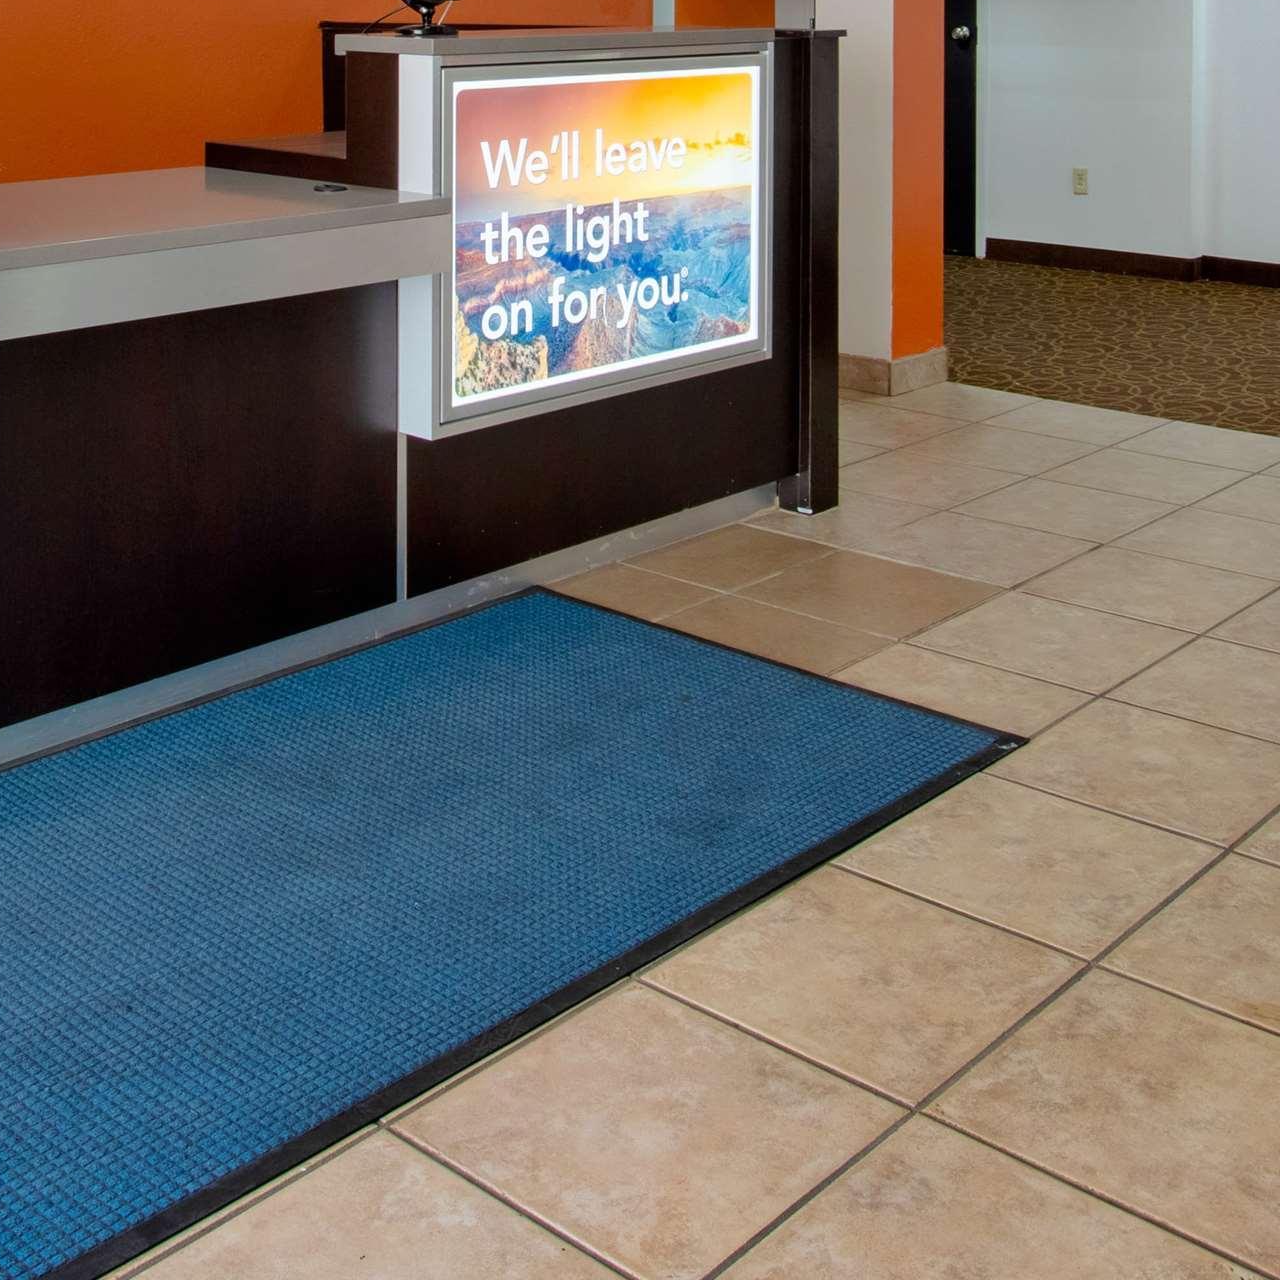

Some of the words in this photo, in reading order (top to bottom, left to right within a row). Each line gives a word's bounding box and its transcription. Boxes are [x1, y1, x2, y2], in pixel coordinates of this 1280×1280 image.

[480, 130, 580, 188] We'll
[595, 128, 687, 177] leave
[480, 211, 550, 265] the
[566, 198, 650, 264] light
[481, 300, 533, 340] on
[548, 276, 607, 327] for
